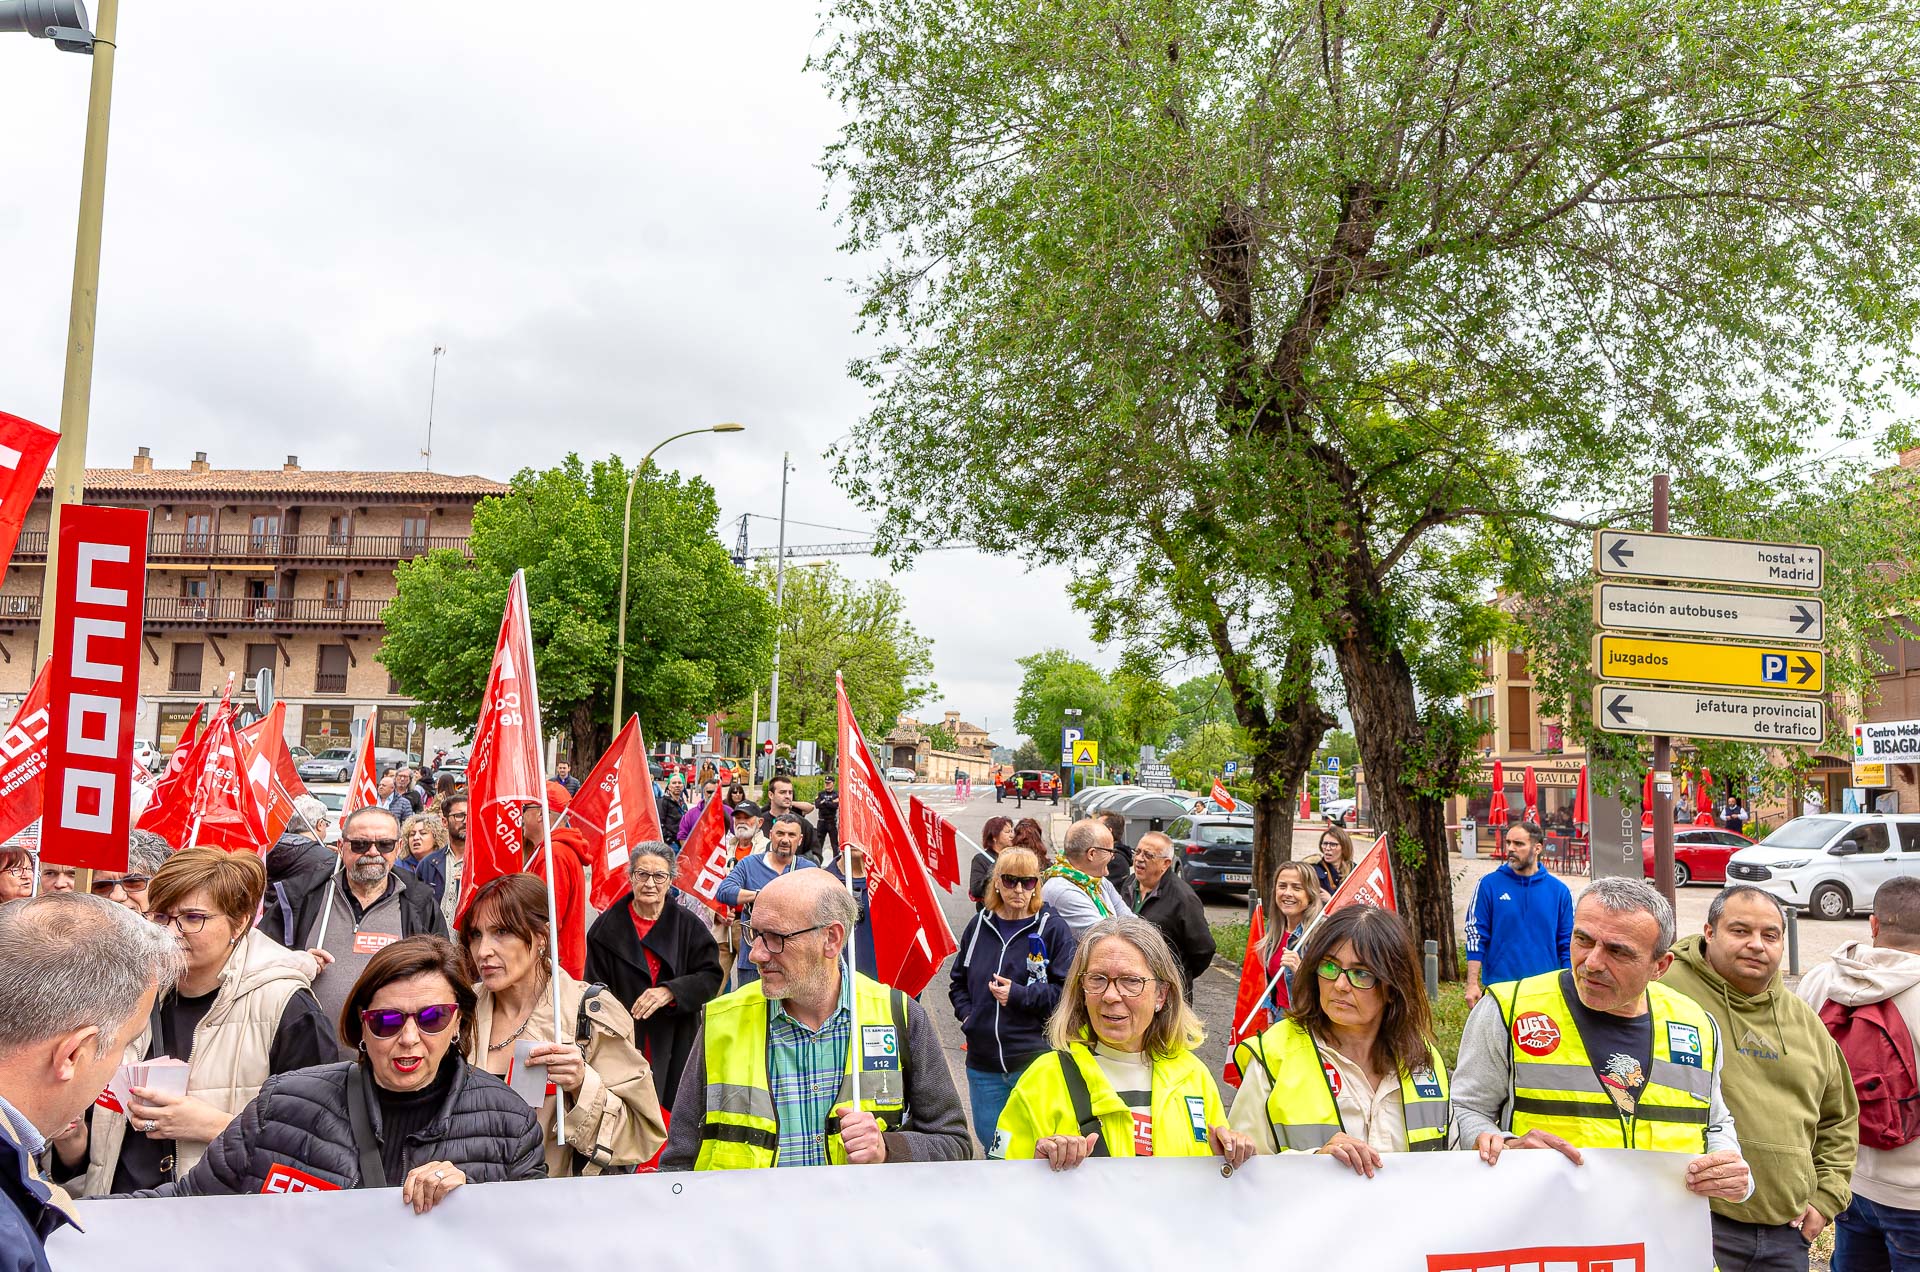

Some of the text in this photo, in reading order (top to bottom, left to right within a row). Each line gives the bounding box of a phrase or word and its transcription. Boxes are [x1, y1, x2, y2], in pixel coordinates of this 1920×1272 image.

[1758, 551, 1795, 564] hostal
[1769, 566, 1814, 581] Madrid
[1609, 600, 1738, 620] estación autobuses
[1608, 650, 1783, 680] juzgados P
[60, 541, 130, 834] CCOO
[1696, 699, 1817, 719] jefatura provincial
[1754, 721, 1817, 736] de trafico
[1867, 727, 1896, 738] Centro
[1065, 729, 1081, 749] P
[1226, 763, 1236, 773] P
[1509, 772, 1524, 782] LO
[1535, 772, 1578, 784] GAVILA
[600, 782, 612, 792] de
[1621, 807, 1634, 864] TOLEDO
[1517, 1014, 1551, 1036] UGT
[1680, 1055, 1695, 1064] 112
[1753, 1049, 1779, 1061] PLAN
[873, 1060, 890, 1068] 112
[1423, 1088, 1437, 1096] 112
